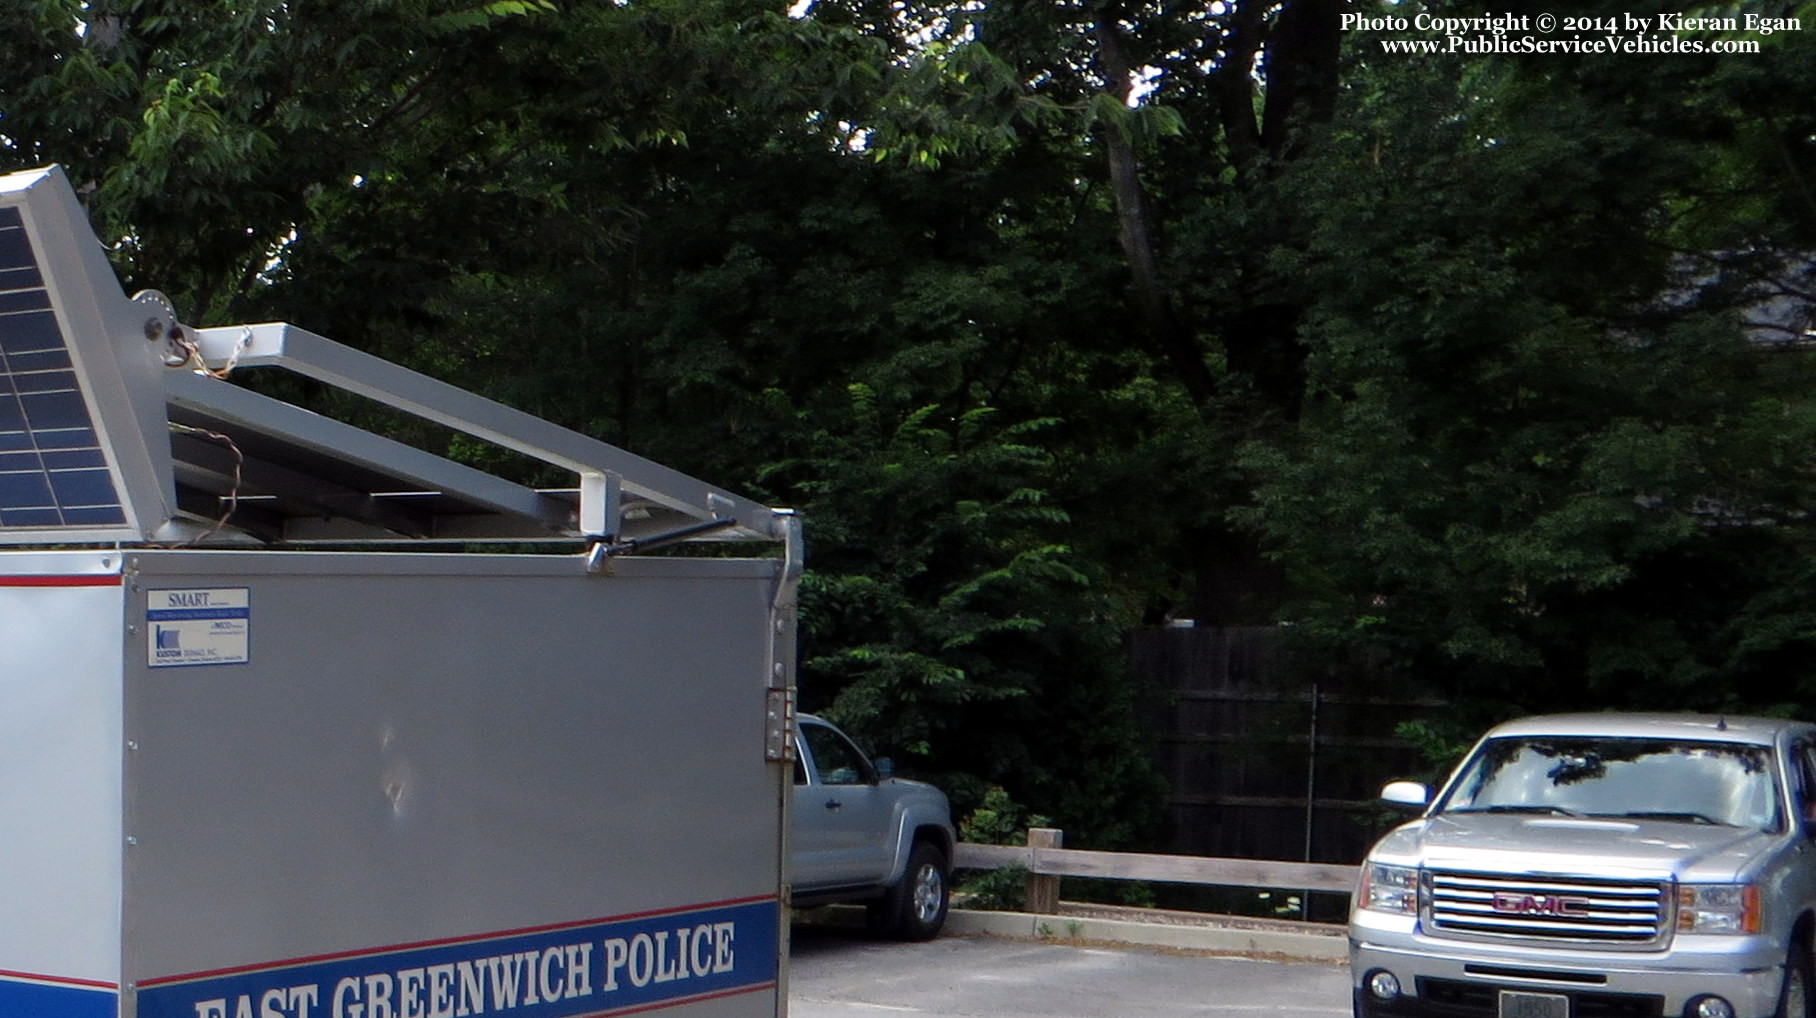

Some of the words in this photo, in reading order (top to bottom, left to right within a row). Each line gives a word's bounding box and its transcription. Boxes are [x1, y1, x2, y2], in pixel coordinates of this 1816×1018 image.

[169, 593, 209, 607] SMART
[1492, 891, 1589, 918] GMC
[603, 921, 735, 992] POLICE
